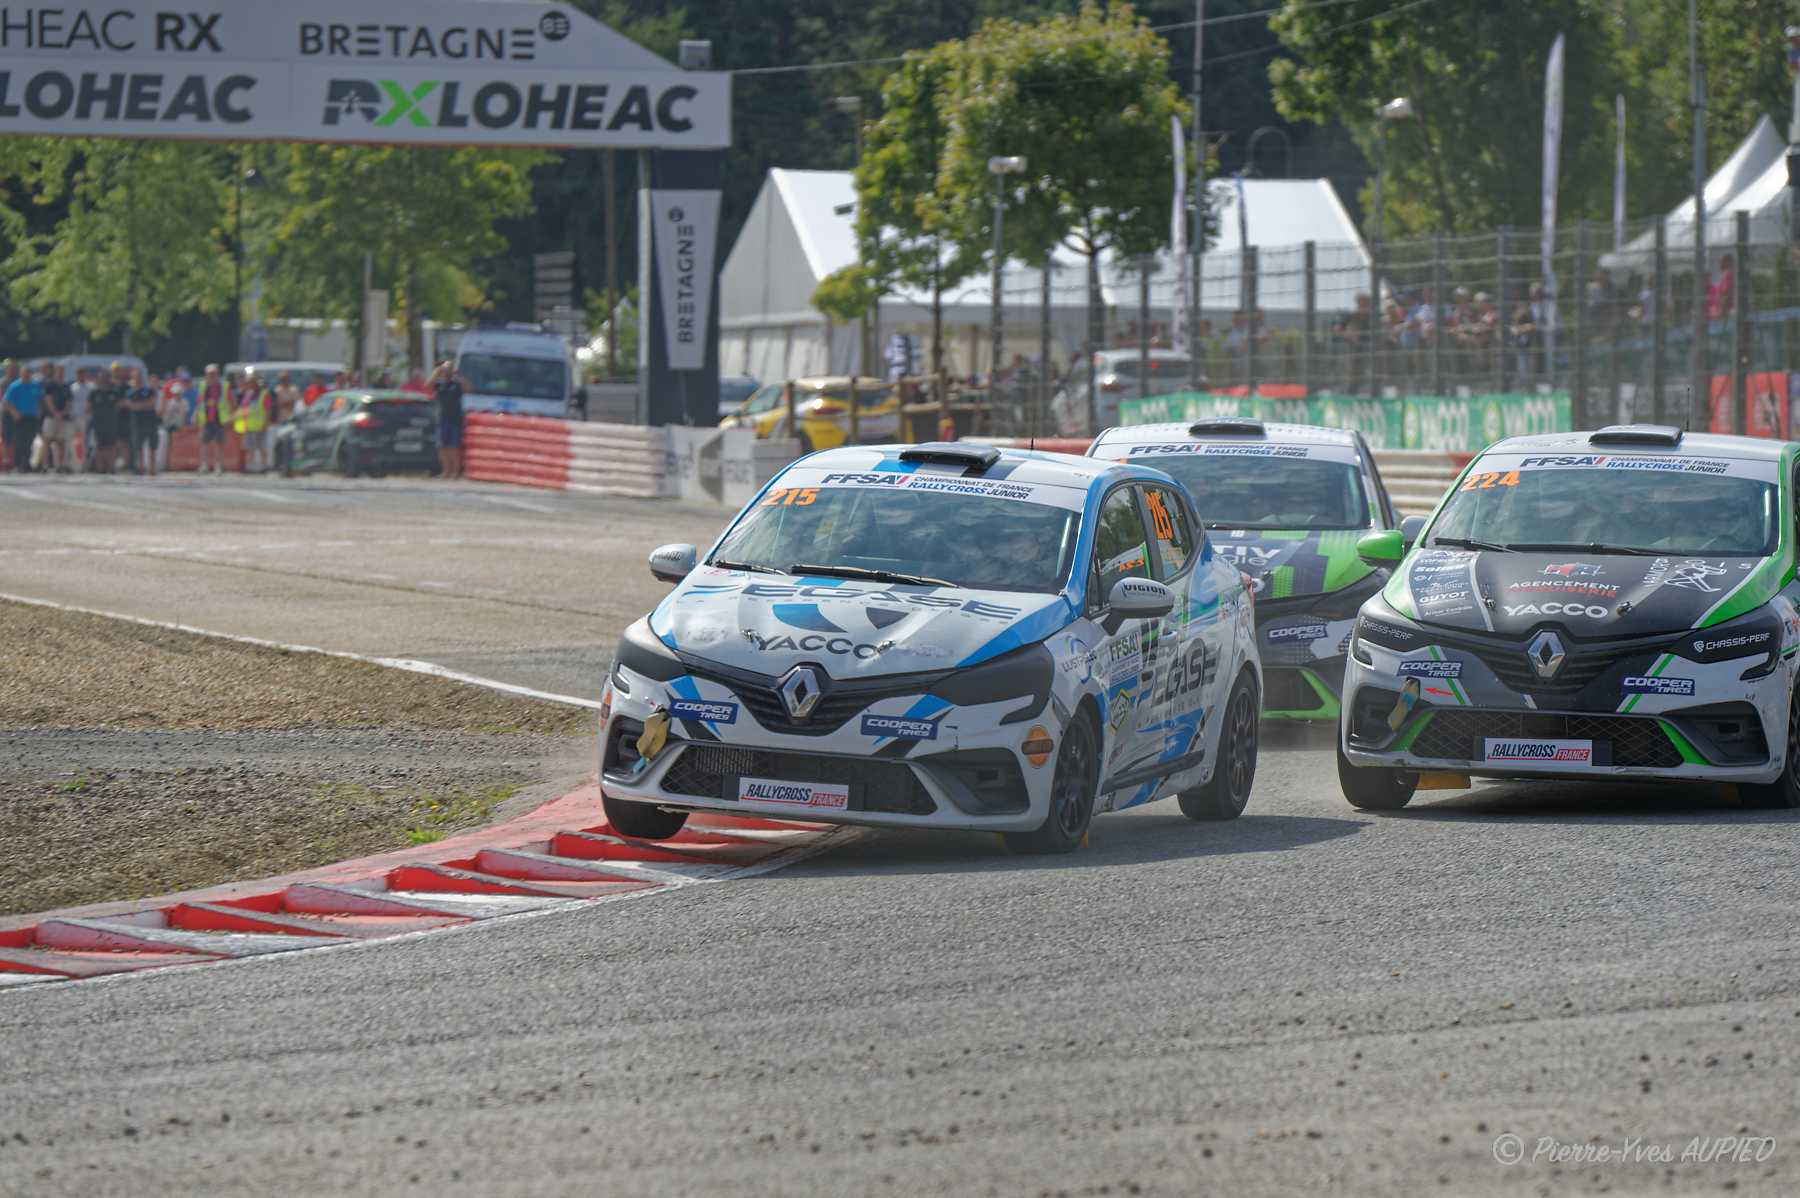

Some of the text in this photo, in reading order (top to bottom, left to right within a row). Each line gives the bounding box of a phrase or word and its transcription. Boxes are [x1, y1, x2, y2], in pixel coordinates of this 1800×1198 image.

[156, 12, 223, 51] RX
[299, 22, 536, 60] BRETAGNE
[677, 224, 695, 343] BRETAGNE
[1129, 444, 1194, 455] FFSA
[1204, 448, 1271, 456] RALLYCROSS
[1520, 456, 1595, 467] FFSA
[1606, 461, 1727, 474] RALLYCROSS JUNIOR
[1693, 460, 1730, 468] FRANCE
[820, 473, 899, 486] FFSA
[914, 475, 981, 488] CHAMPIONNAT
[997, 482, 1035, 493] FRANCE
[1461, 470, 1521, 492] 224
[907, 480, 1030, 500] RALLYCROSS JUNIOR
[760, 488, 821, 506] 215
[1509, 580, 1621, 591] AGENCEMENT
[1503, 602, 1609, 619] YACCO
[1268, 625, 1326, 639] COOPER
[754, 635, 880, 660] YACCO
[1705, 632, 1771, 650] CHASSIS-PERF
[1400, 662, 1462, 671] COOPER
[1427, 670, 1459, 678] TIRES
[1623, 677, 1694, 688] COOPER
[1656, 686, 1691, 694] TIRES
[674, 702, 732, 714] COOPER
[699, 711, 730, 721] TIRES
[866, 718, 933, 730] COOPER
[897, 728, 930, 737] TIRES
[1491, 743, 1589, 761] RALLYCROSS FRANCE
[746, 783, 812, 801] RALLYCROSS
